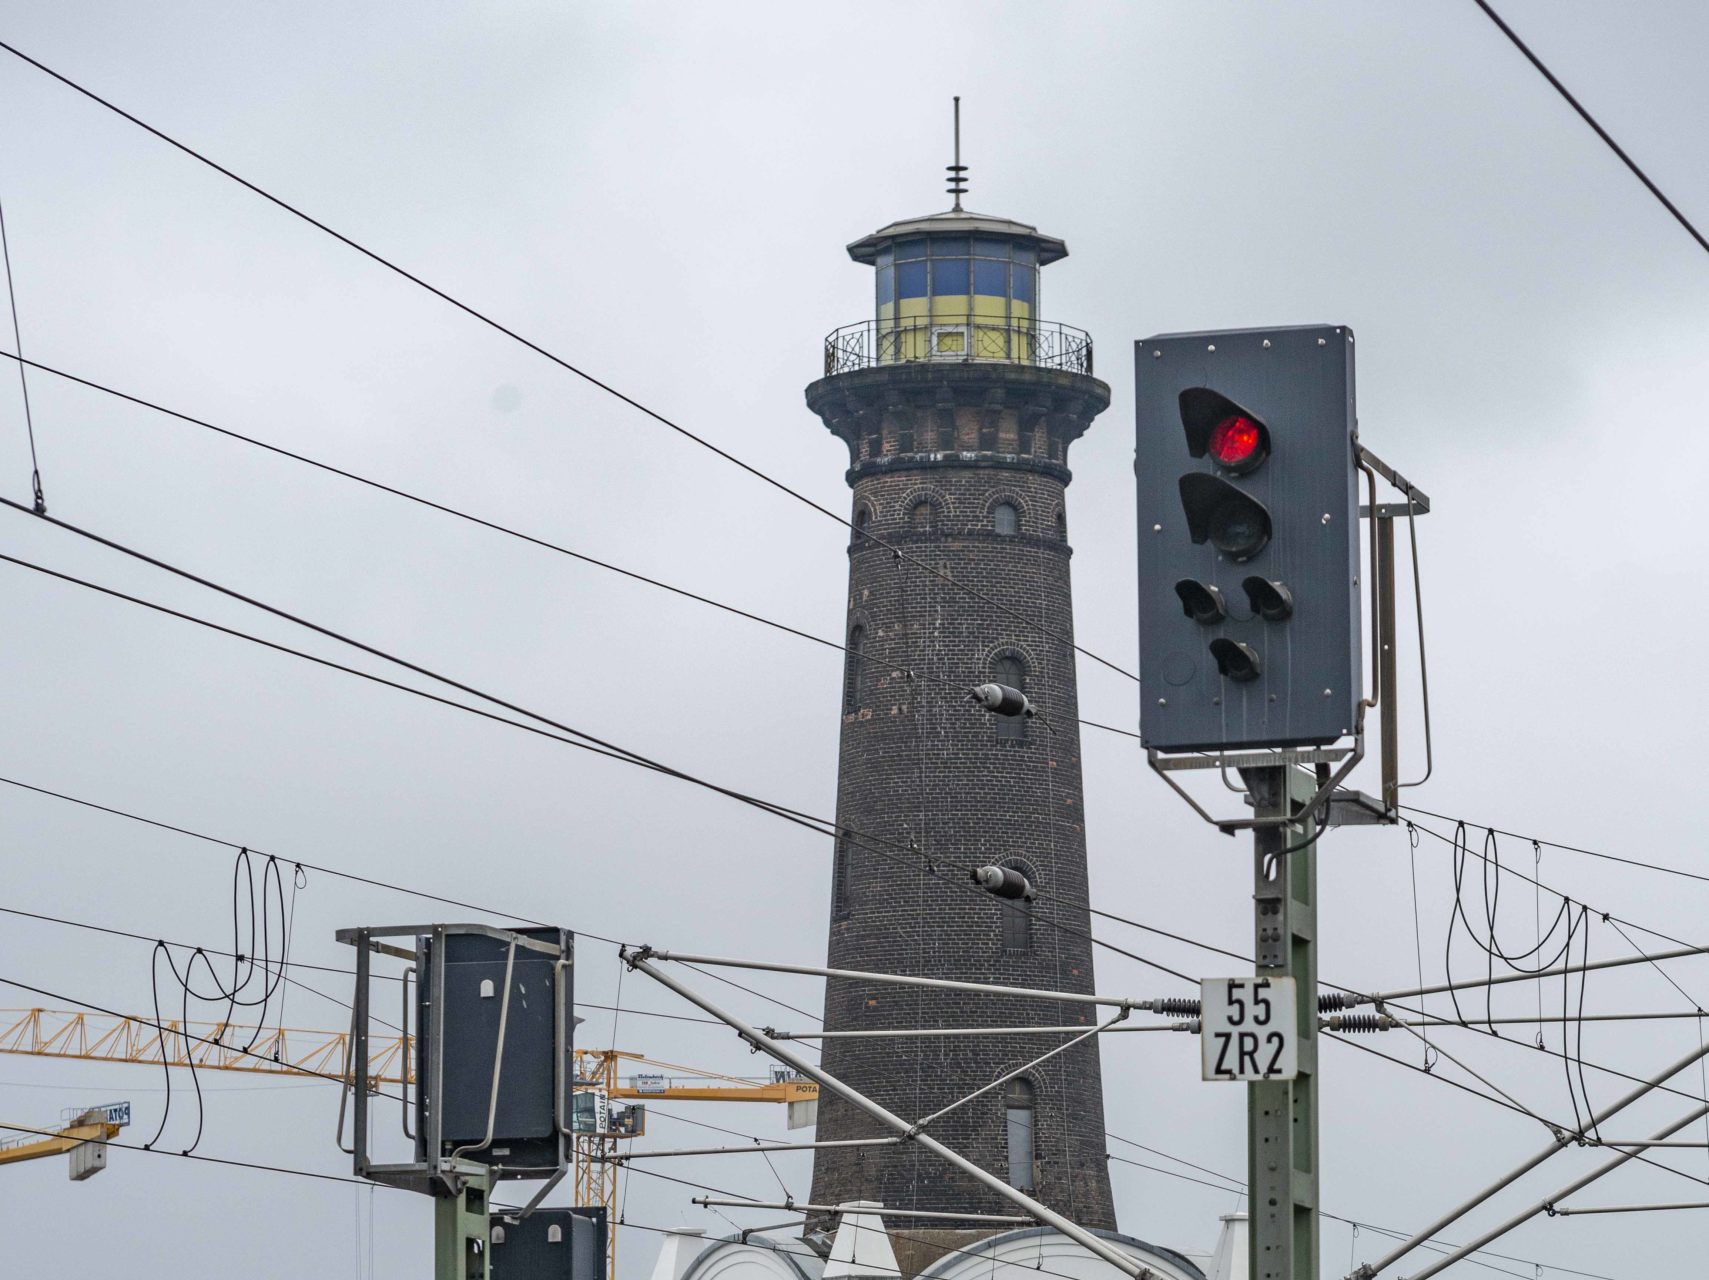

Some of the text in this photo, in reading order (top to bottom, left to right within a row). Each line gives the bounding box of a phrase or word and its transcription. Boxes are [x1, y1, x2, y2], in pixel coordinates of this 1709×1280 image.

[1226, 982, 1271, 1027] 55
[1213, 1030, 1285, 1076] ZR2
[598, 1093, 606, 1130] POTAIN
